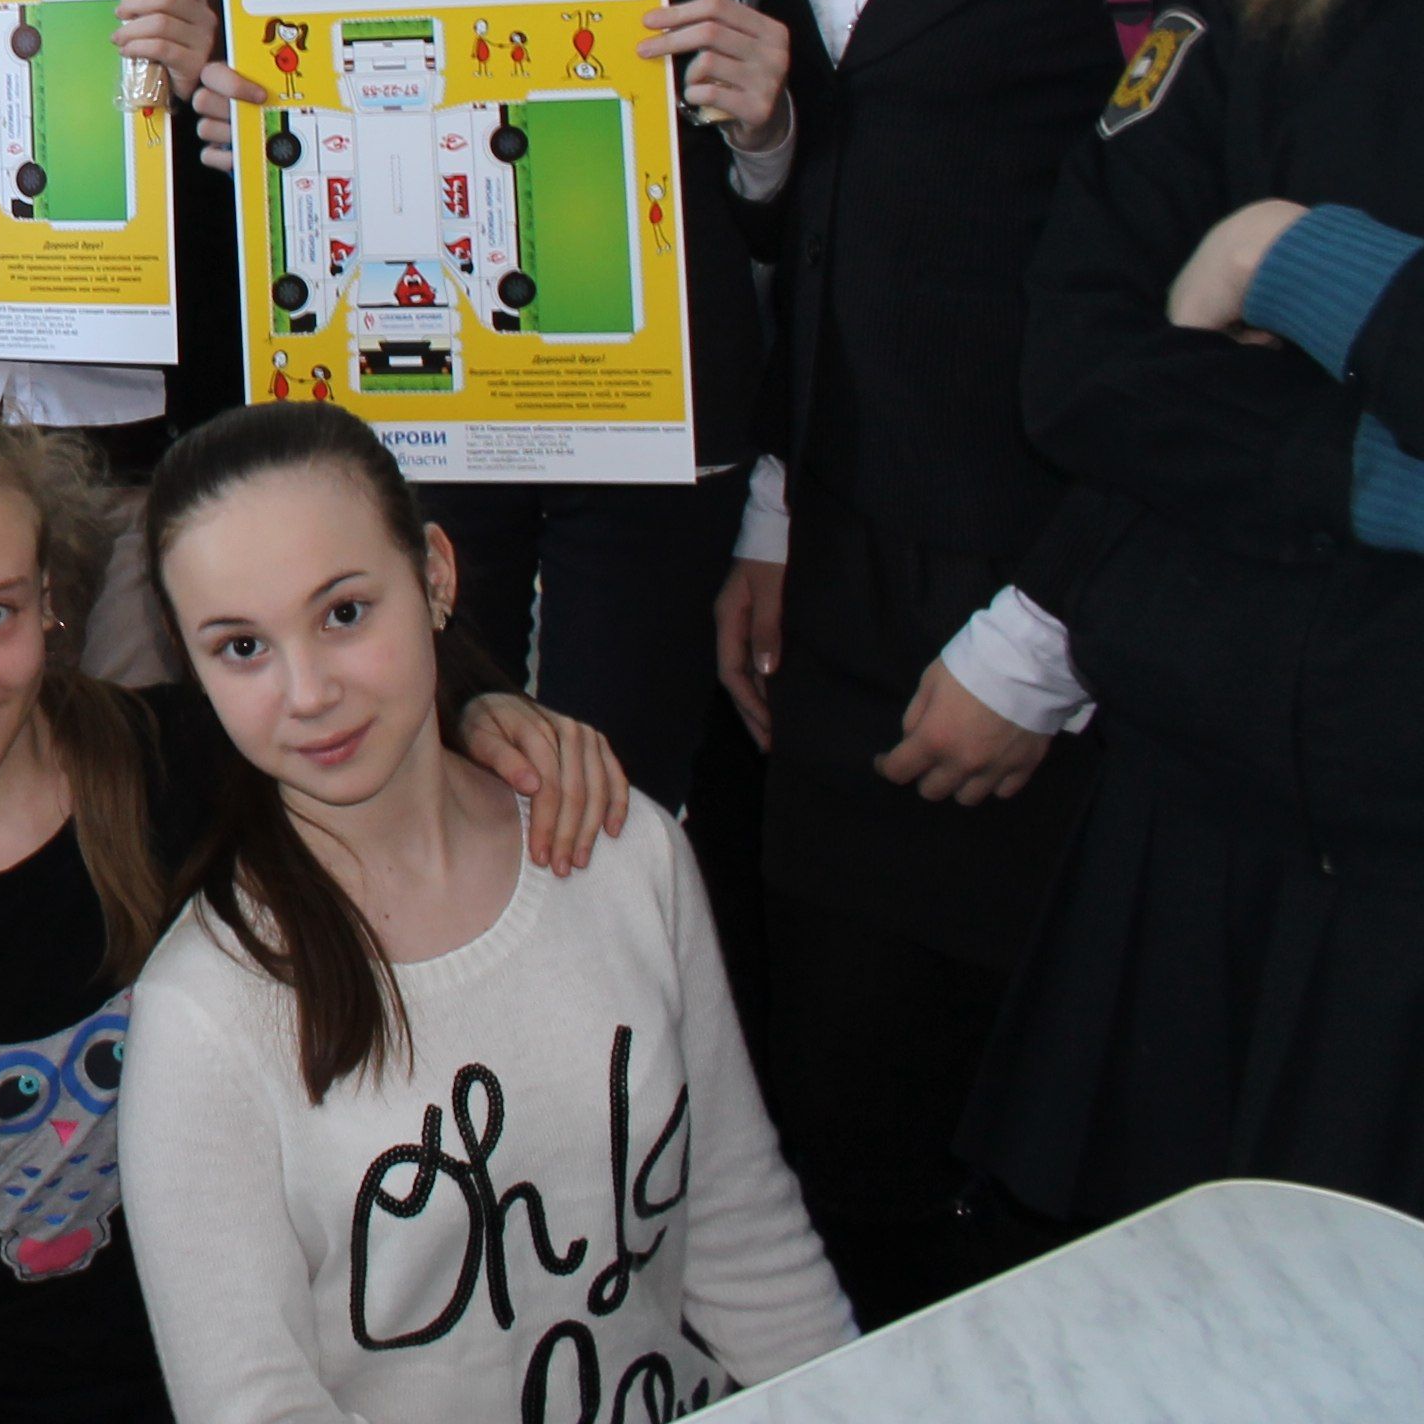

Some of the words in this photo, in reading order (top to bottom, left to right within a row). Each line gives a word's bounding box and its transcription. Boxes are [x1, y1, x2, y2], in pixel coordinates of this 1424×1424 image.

[382, 431, 446, 445] КРОВИ
[397, 452, 449, 465] бласти
[350, 1062, 589, 1352] Oh
